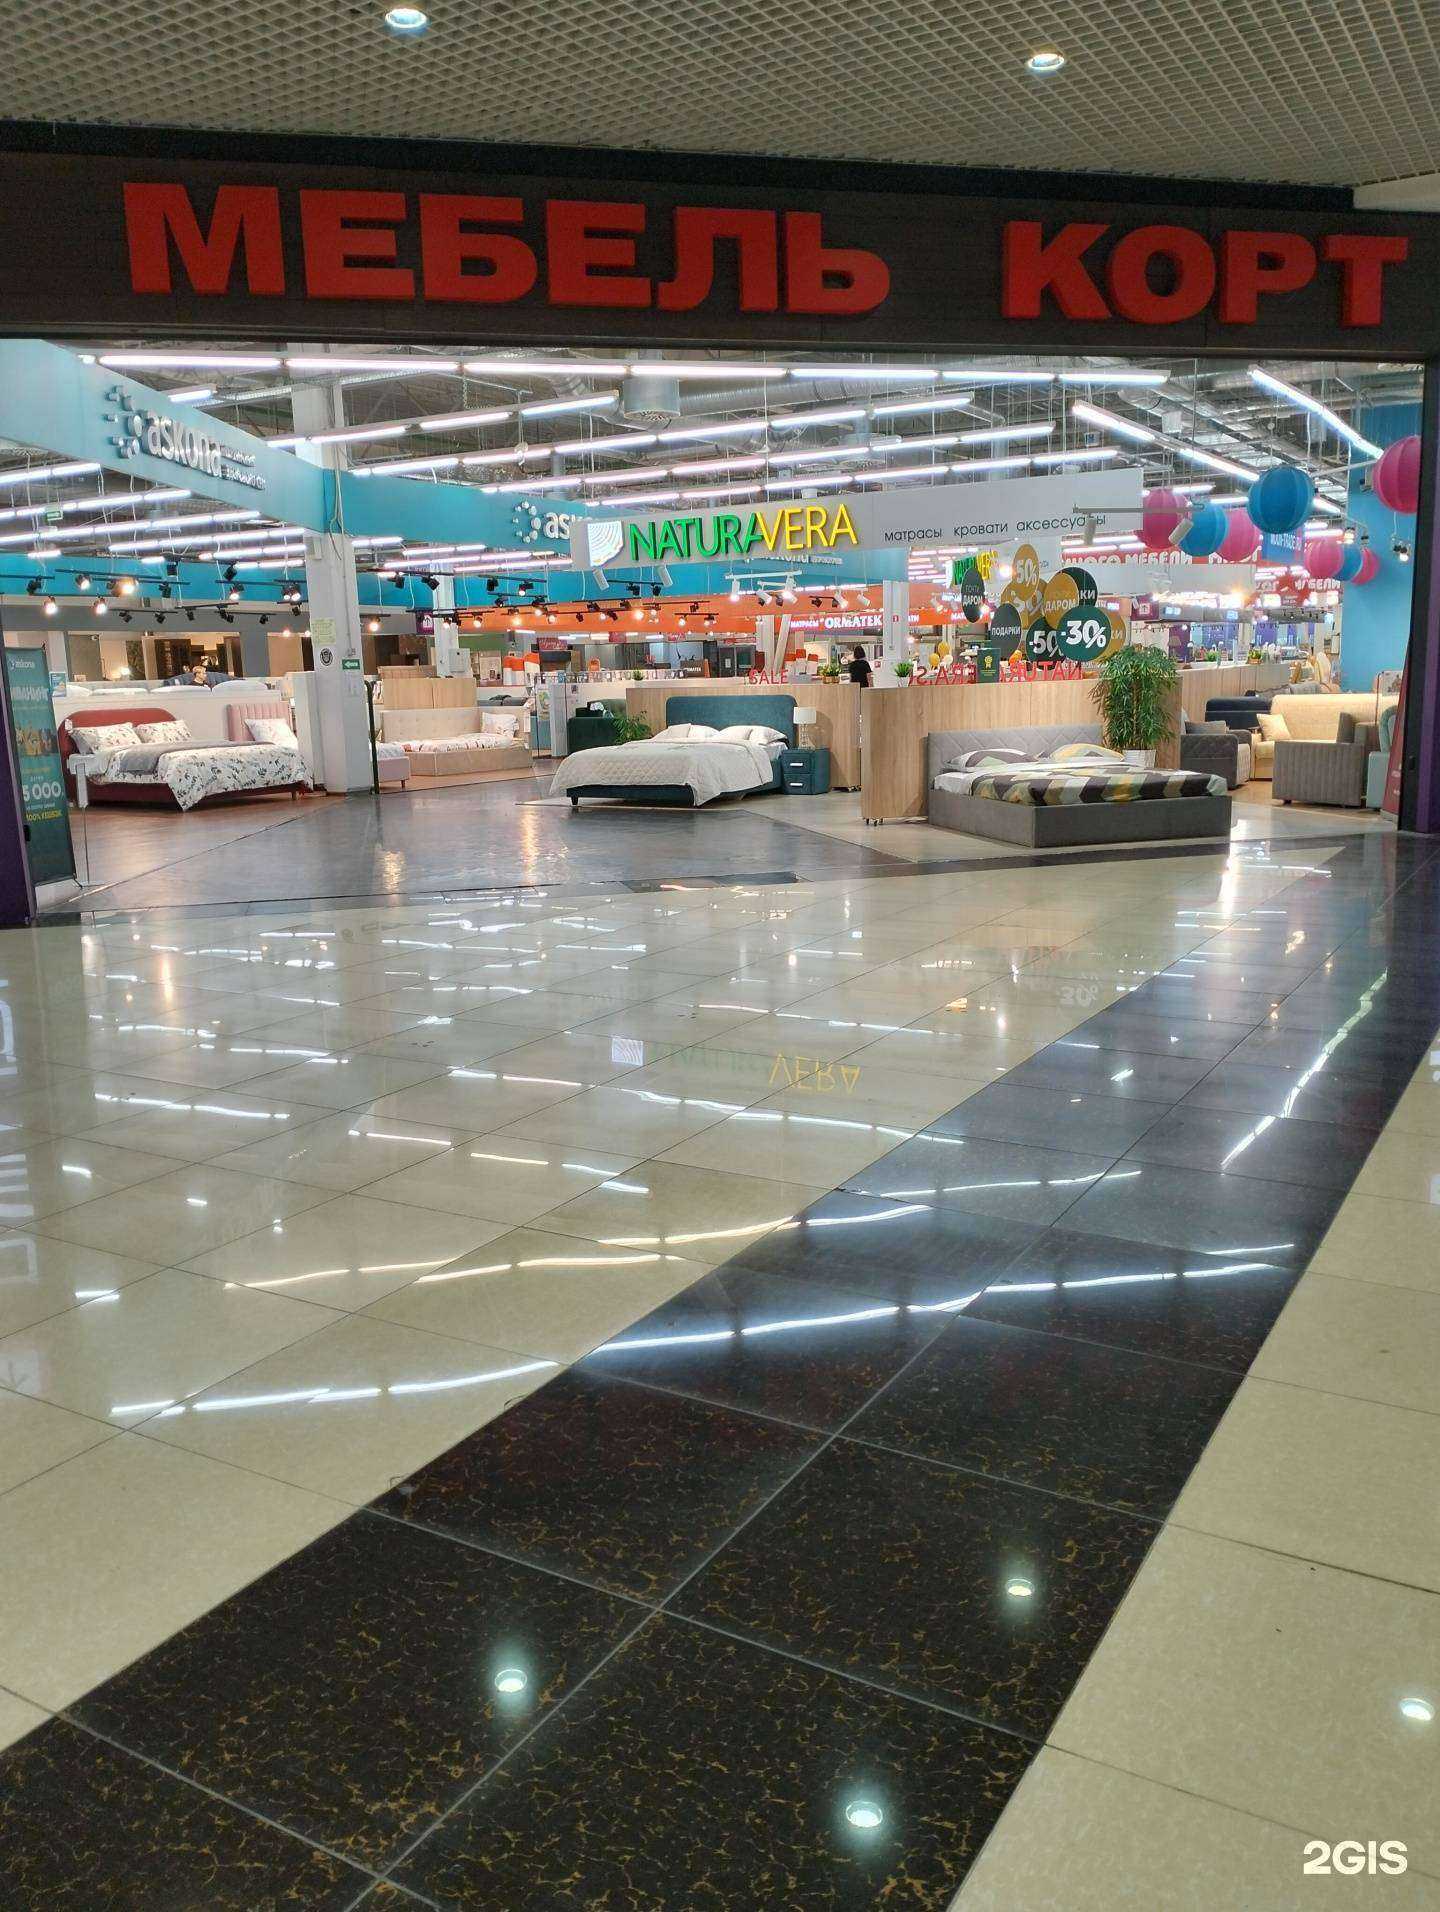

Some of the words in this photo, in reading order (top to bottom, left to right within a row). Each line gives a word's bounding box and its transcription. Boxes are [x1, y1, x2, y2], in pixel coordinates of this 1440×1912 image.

[122, 182, 891, 315] МЕБЕЛЬ
[1003, 220, 1410, 327] КОРТ
[143, 409, 222, 478] askona
[629, 503, 858, 560] NATURAVERA
[884, 527, 943, 543] матрасы
[953, 521, 1009, 539] кровати
[1016, 515, 1107, 531] аксессуаы
[991, 626, 1021, 636] ПОДАРКИ
[1061, 619, 1107, 649] -30%
[749, 669, 788, 685] SALE
